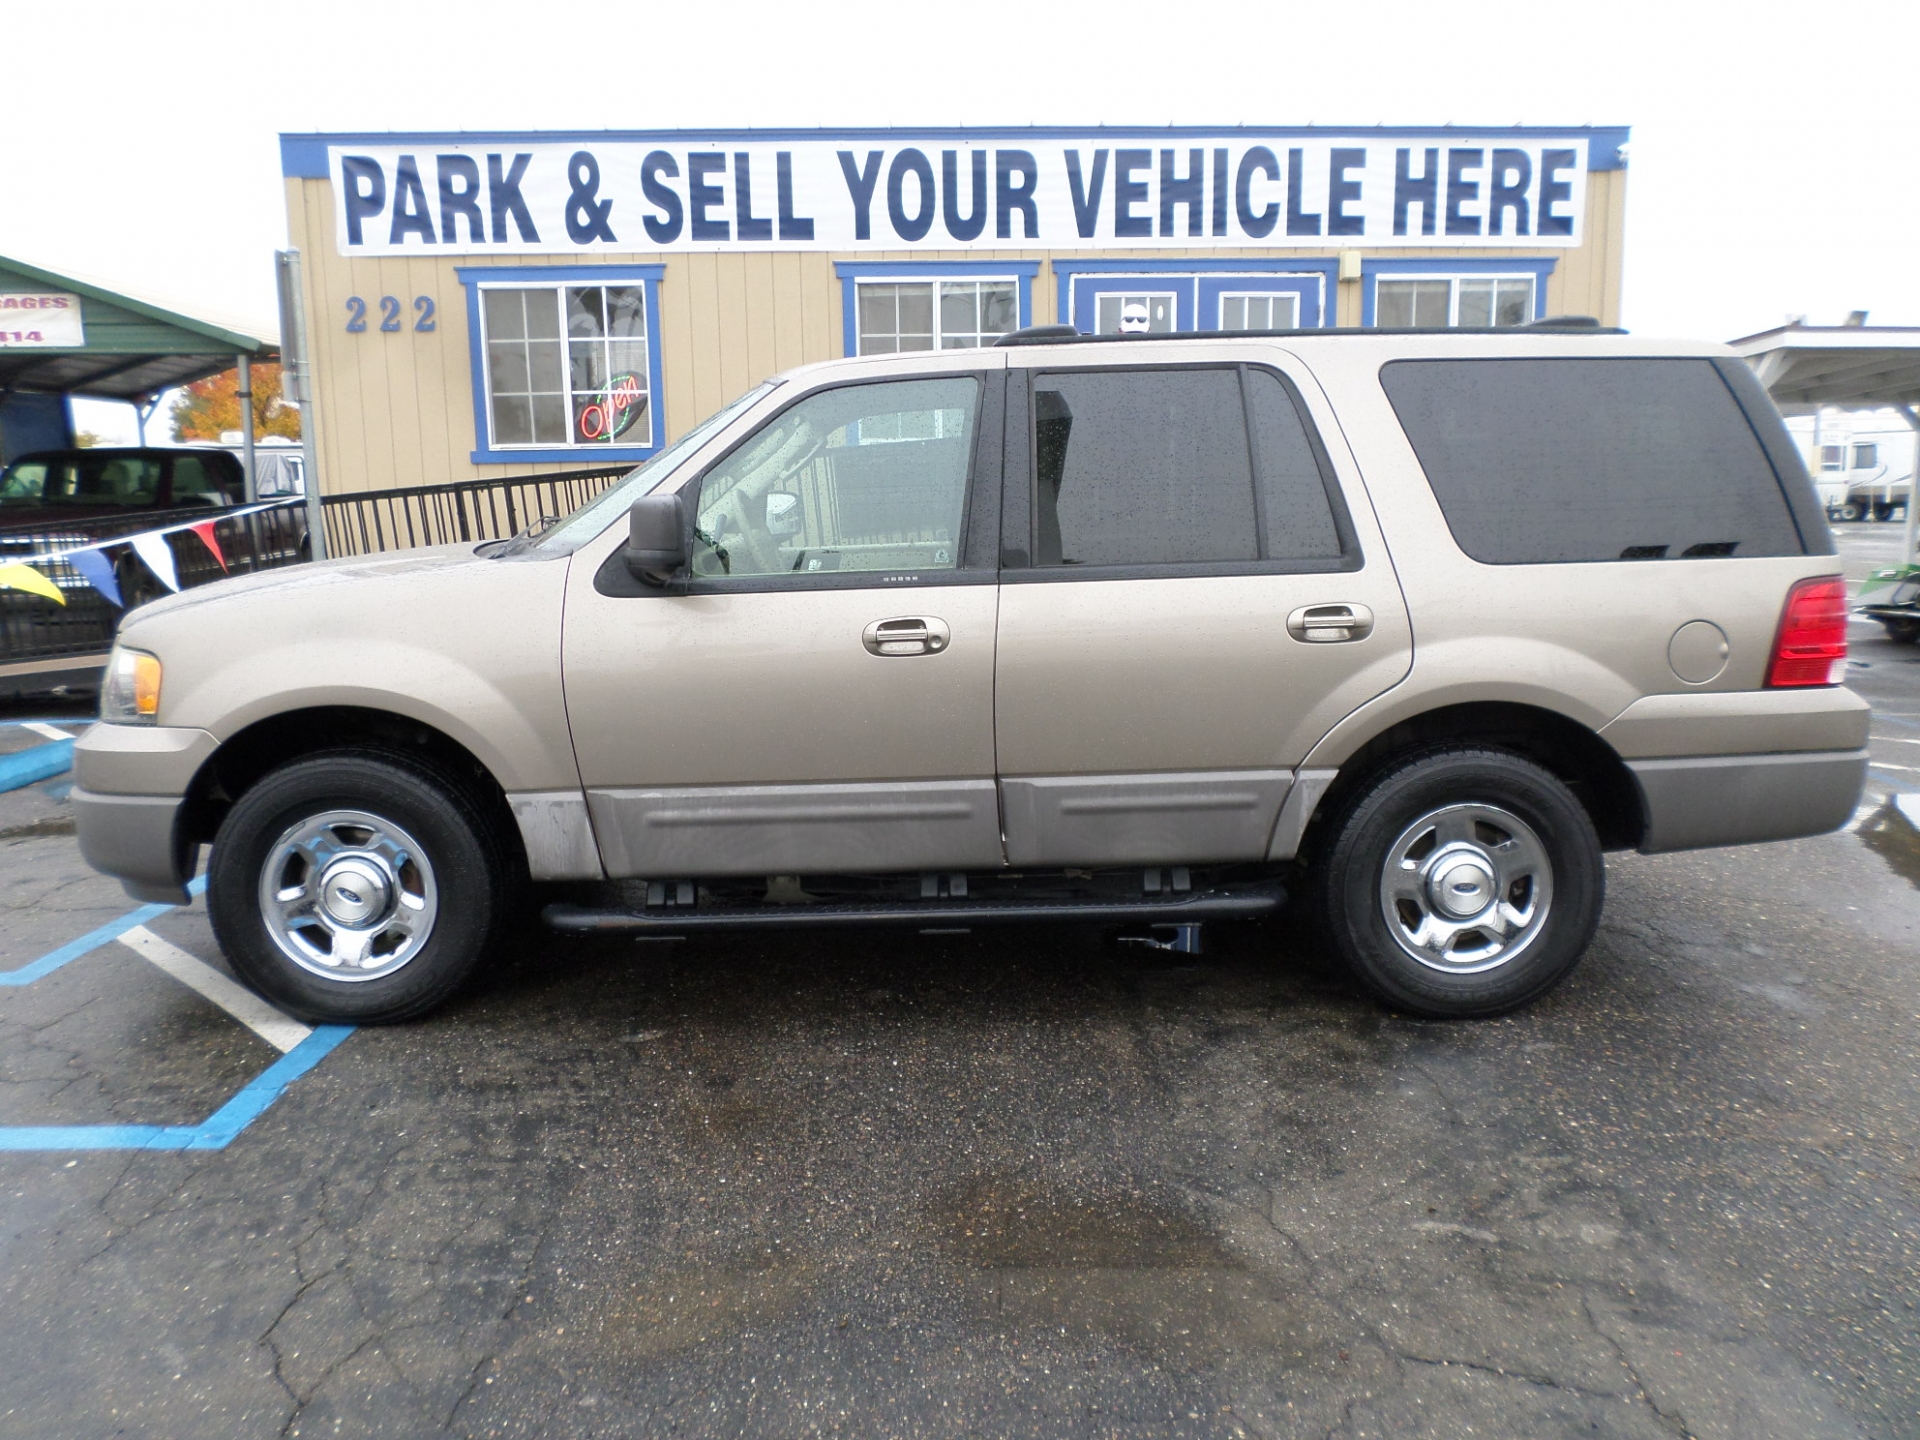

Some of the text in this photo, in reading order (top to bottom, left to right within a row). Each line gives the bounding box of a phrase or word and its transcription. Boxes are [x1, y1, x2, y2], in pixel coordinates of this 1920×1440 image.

[343, 147, 1574, 245] PARK & SELL YOUR VEHICLE HERE
[0, 297, 69, 309] AGES
[345, 296, 437, 333] 222
[580, 375, 640, 439] Open
